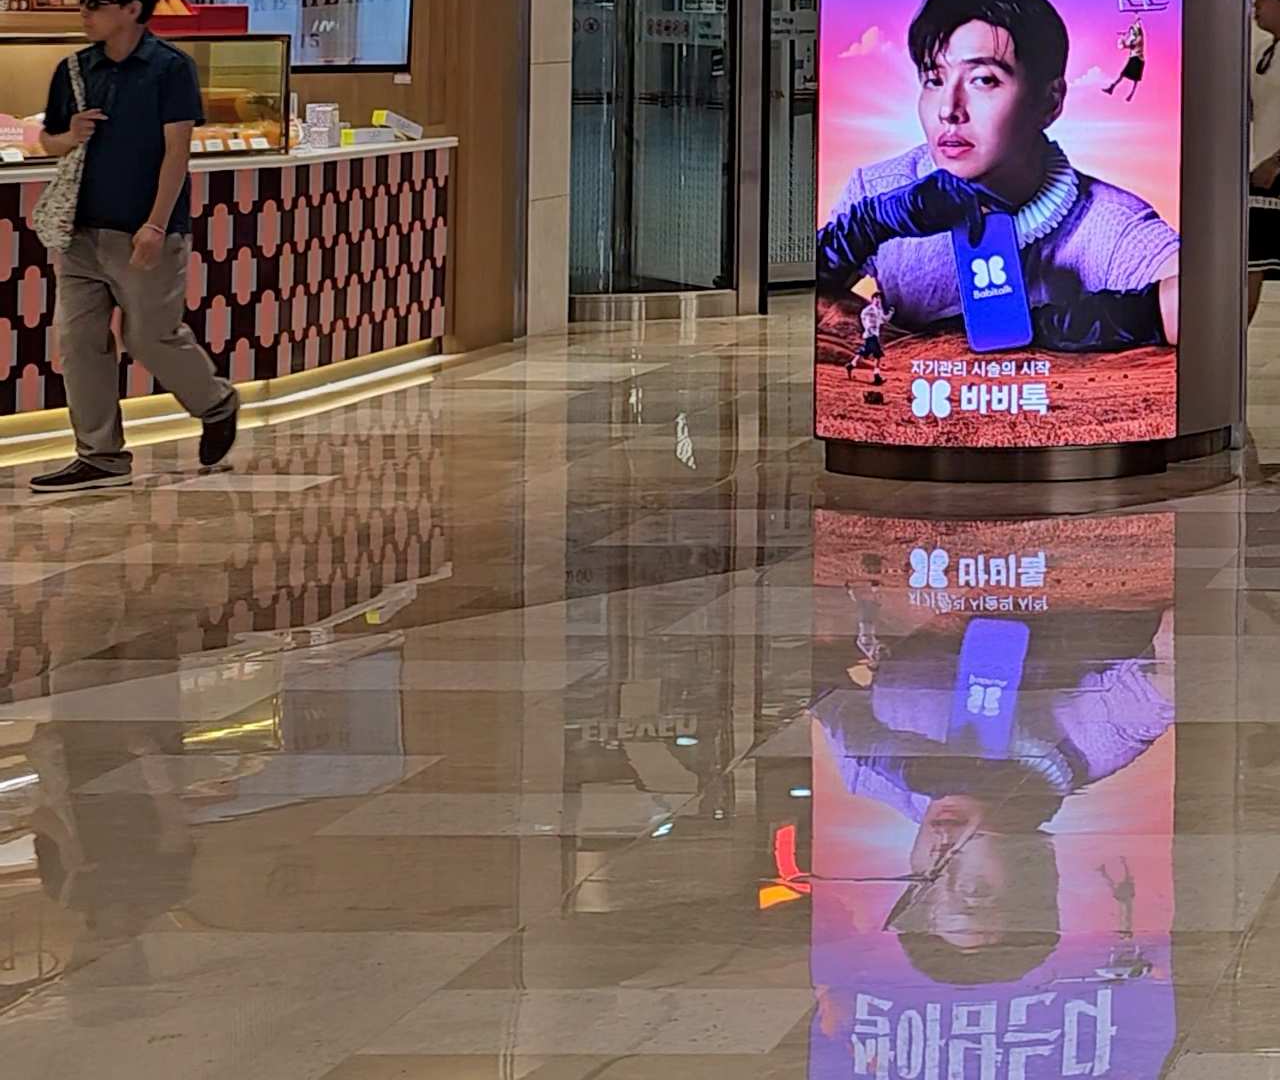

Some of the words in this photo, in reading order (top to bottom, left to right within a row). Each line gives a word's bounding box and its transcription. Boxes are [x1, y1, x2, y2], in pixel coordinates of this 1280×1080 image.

[911, 360, 967, 377] 자기관리
[971, 360, 1016, 377] 시술의
[1021, 360, 1050, 377] 시작
[960, 383, 1049, 415] 바비톡
